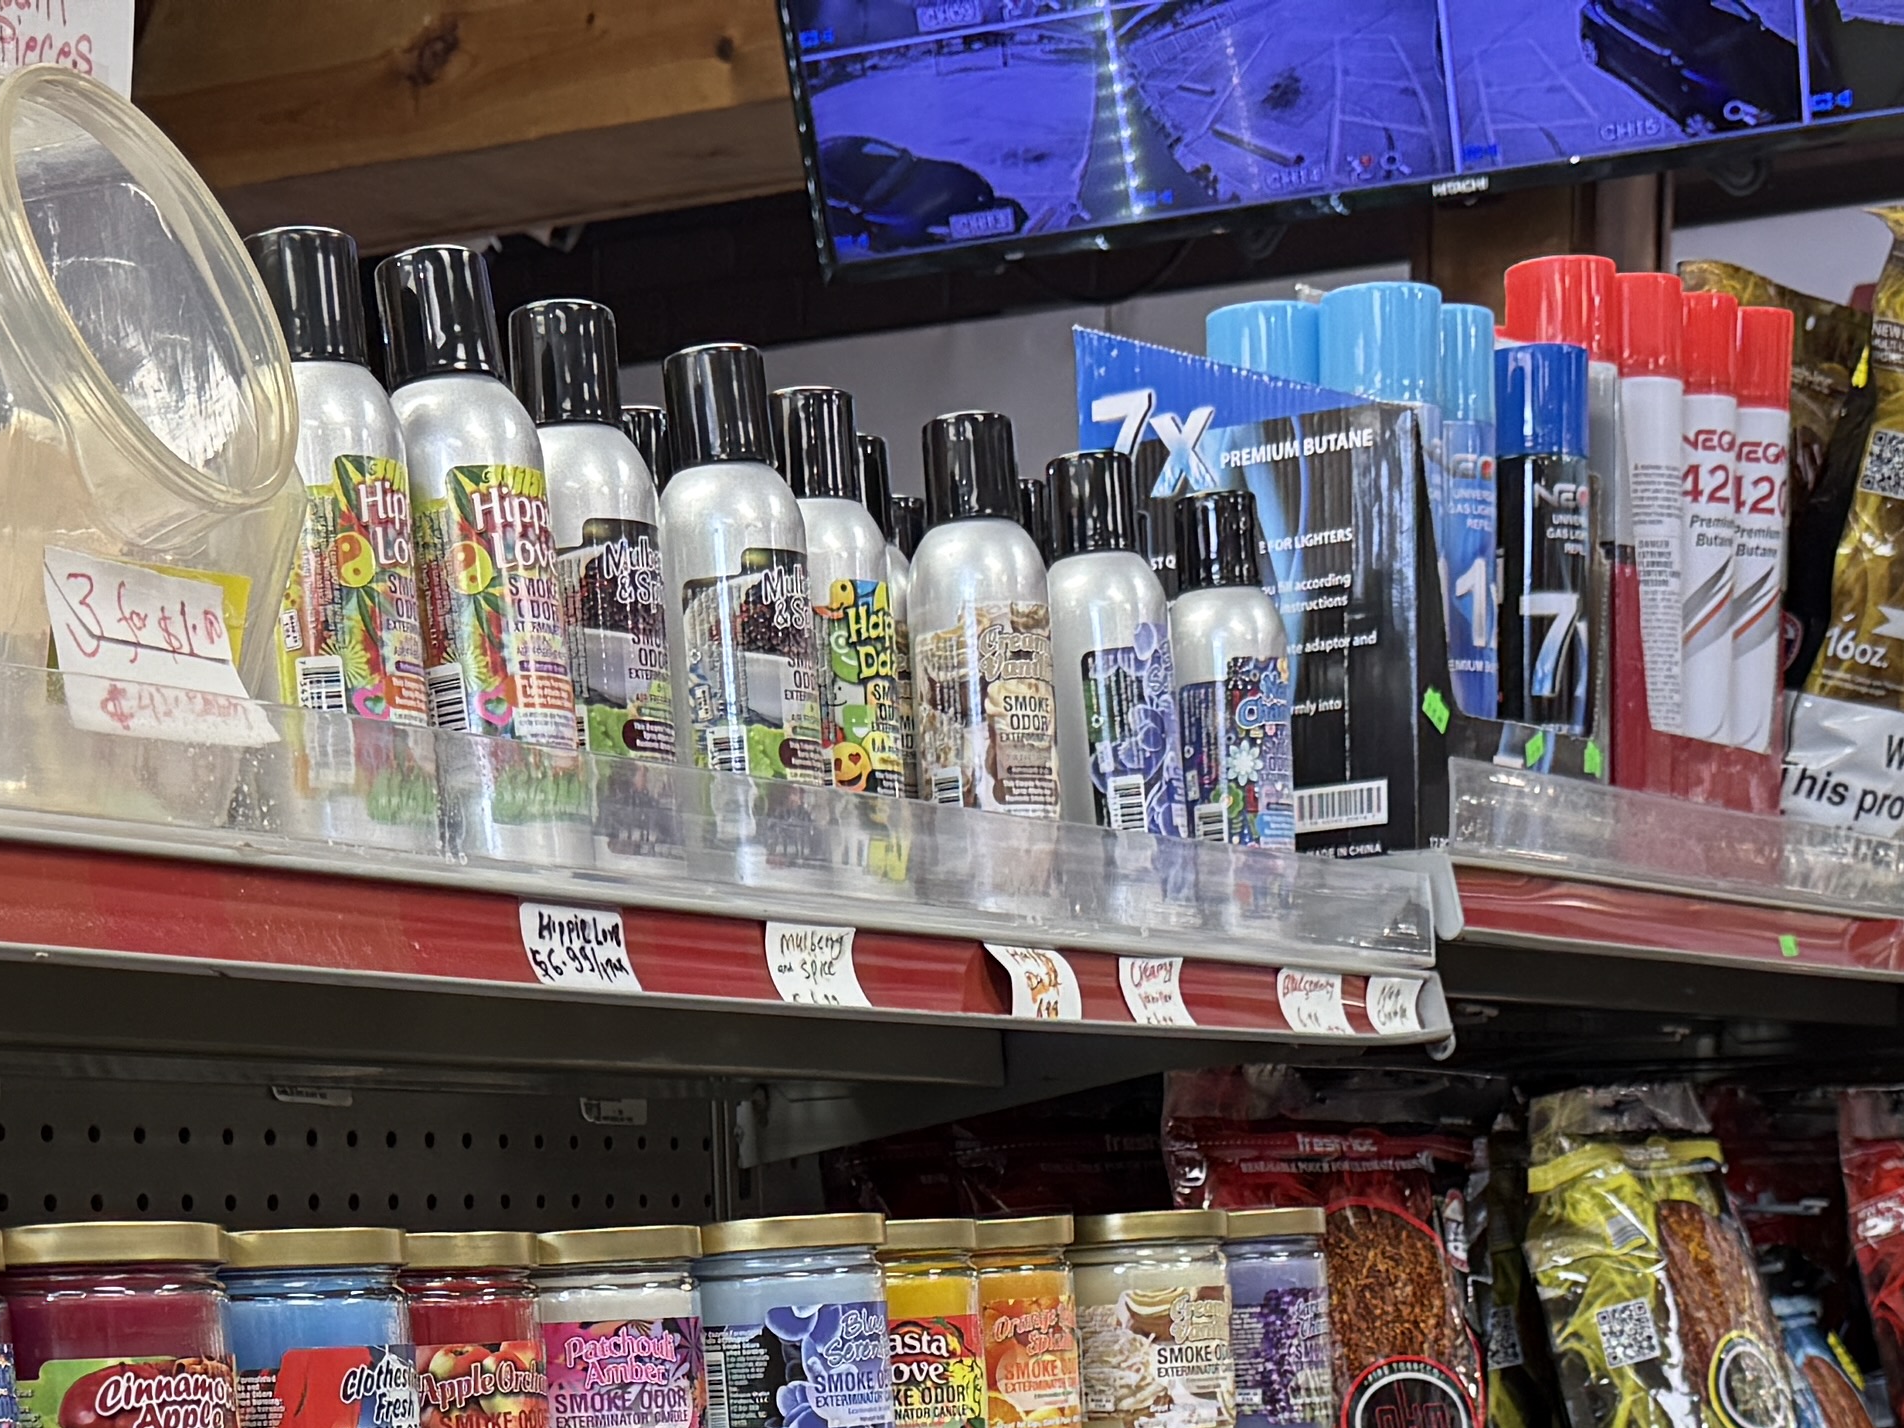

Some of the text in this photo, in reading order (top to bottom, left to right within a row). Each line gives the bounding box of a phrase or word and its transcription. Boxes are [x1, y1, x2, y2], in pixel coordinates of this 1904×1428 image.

[1219, 430, 1373, 469] PREMIUM BUTANE
[1295, 528, 1353, 551] LIGHTERS
[65, 572, 101, 658] 3
[117, 581, 149, 664] for
[1824, 624, 1890, 670] 16oz.
[1002, 695, 1051, 715] SMOKE
[1010, 711, 1049, 731] ODOR
[1344, 842, 1382, 856] CHINA
[538, 912, 591, 944] Hippie
[564, 1332, 679, 1367] Patchouli
[420, 1364, 494, 1408] Apple
[584, 1360, 668, 1388] Amber
[555, 1386, 689, 1415] SMOKE ODOR
[653, 1407, 689, 1424] CANDLE
